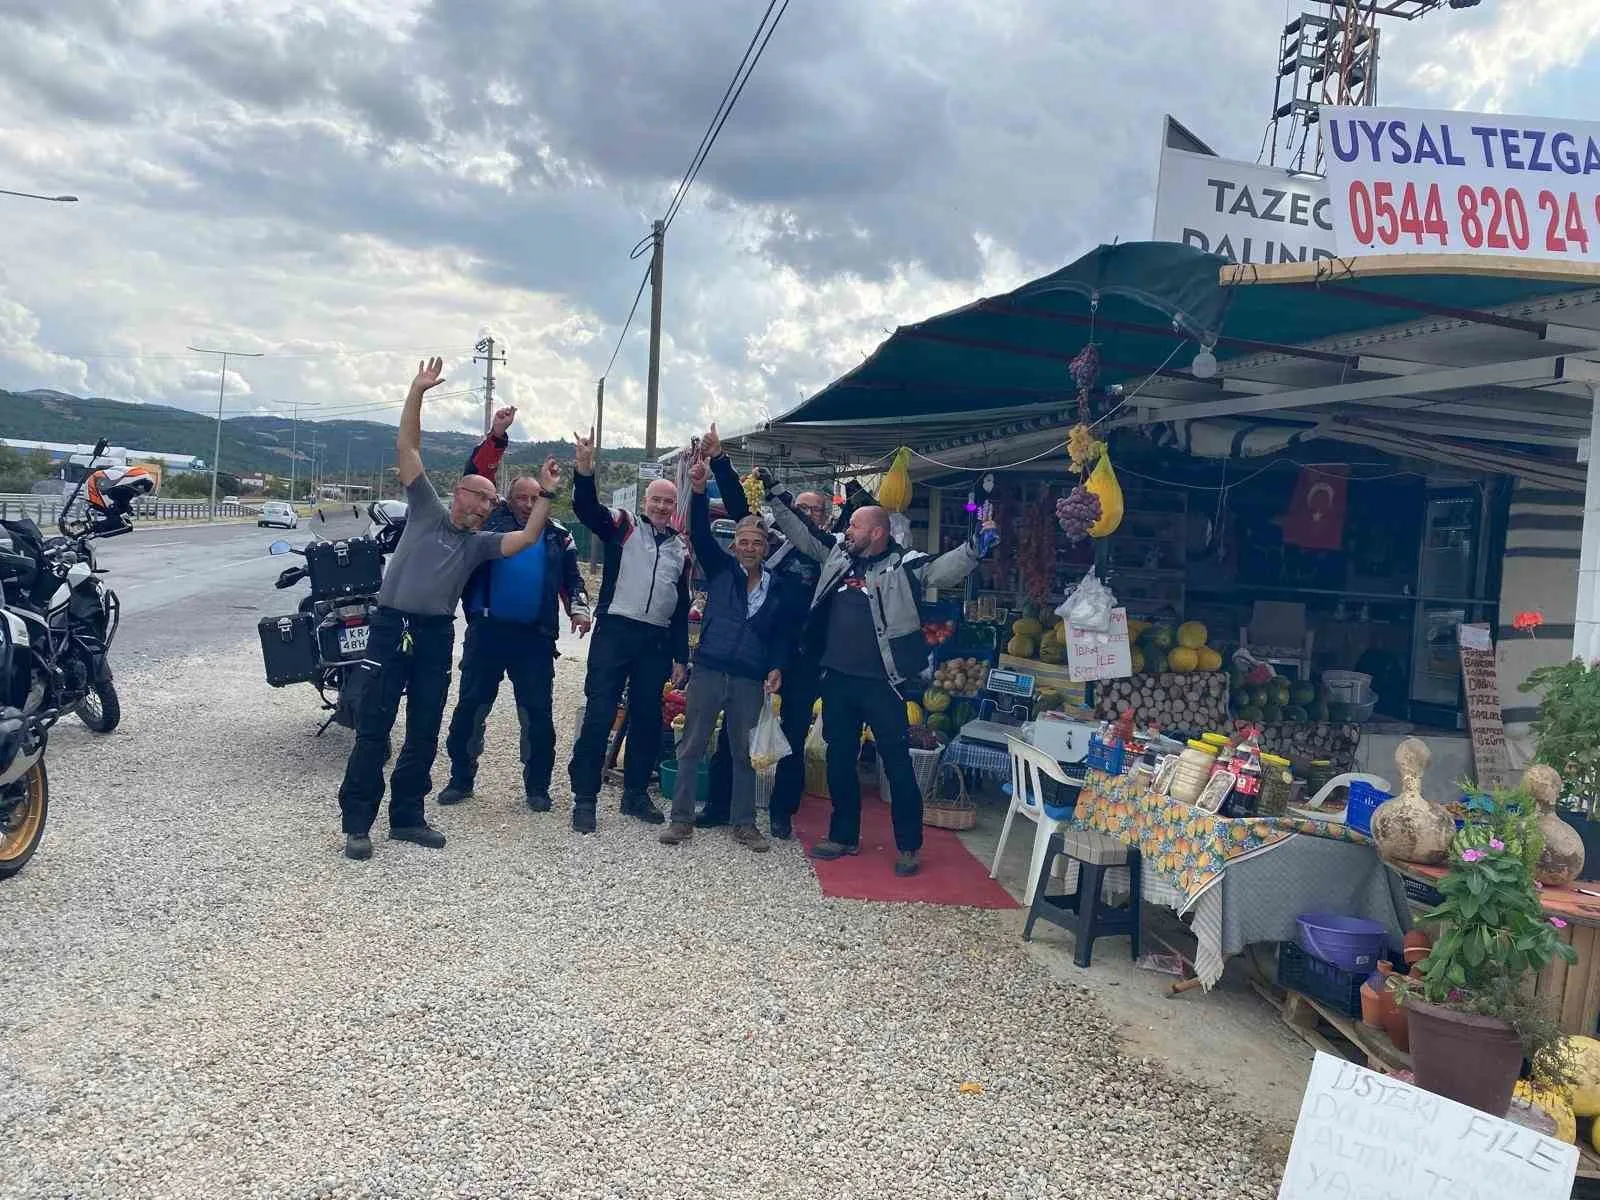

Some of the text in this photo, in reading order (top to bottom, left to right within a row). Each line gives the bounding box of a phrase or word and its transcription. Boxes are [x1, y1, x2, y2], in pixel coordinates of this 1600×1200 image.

[1330, 119, 1465, 166] UYSAL
[1348, 180, 1449, 246] 0544
[1457, 184, 1530, 251] 820
[1539, 190, 1590, 254] 24
